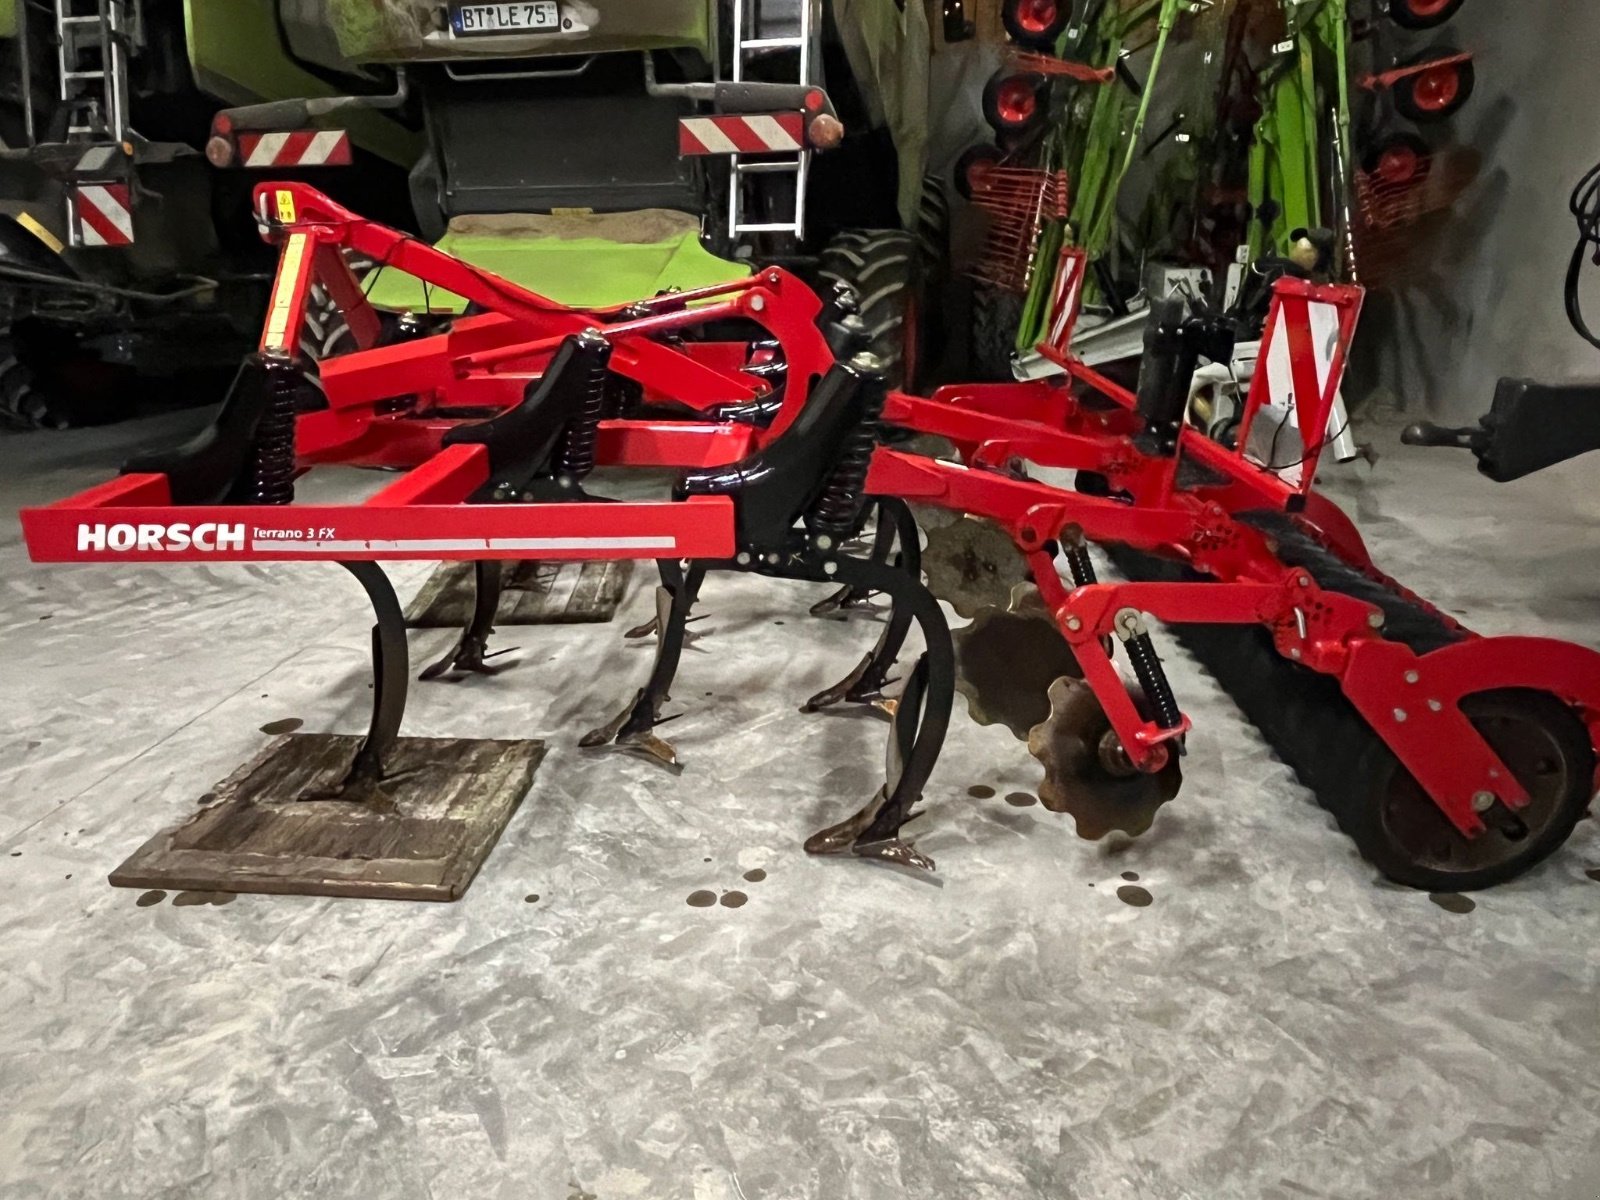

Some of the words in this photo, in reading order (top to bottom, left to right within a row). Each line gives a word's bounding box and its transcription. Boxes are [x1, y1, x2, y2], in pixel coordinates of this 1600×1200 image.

[463, 8, 485, 28] BT
[497, 6, 520, 27] LE
[524, 4, 546, 25] 75
[77, 523, 246, 551] HORSCH
[253, 527, 303, 539] Terrano
[306, 528, 315, 539] 3
[318, 527, 336, 539] FX
